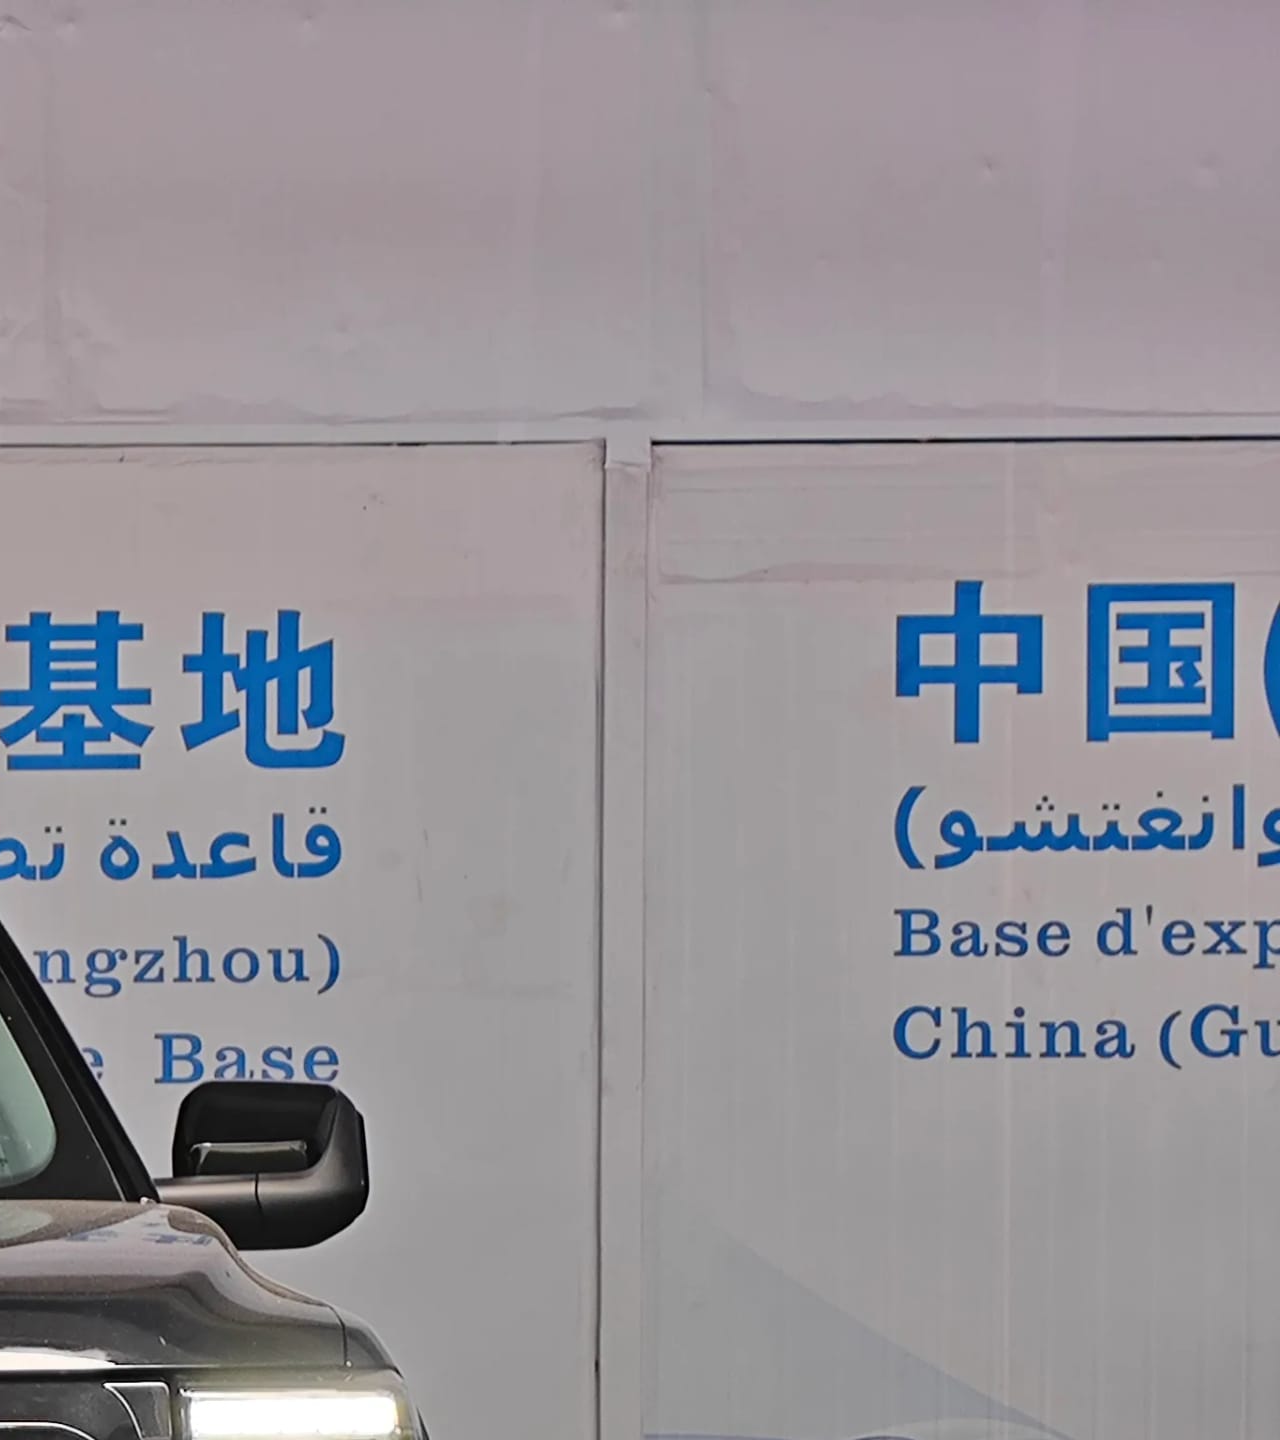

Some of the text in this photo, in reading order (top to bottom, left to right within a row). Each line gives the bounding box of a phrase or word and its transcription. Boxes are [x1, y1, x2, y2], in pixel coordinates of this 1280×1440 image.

[894, 908, 1073, 958] Base
[154, 1032, 340, 1085] Base
[893, 1002, 1137, 1062] China
